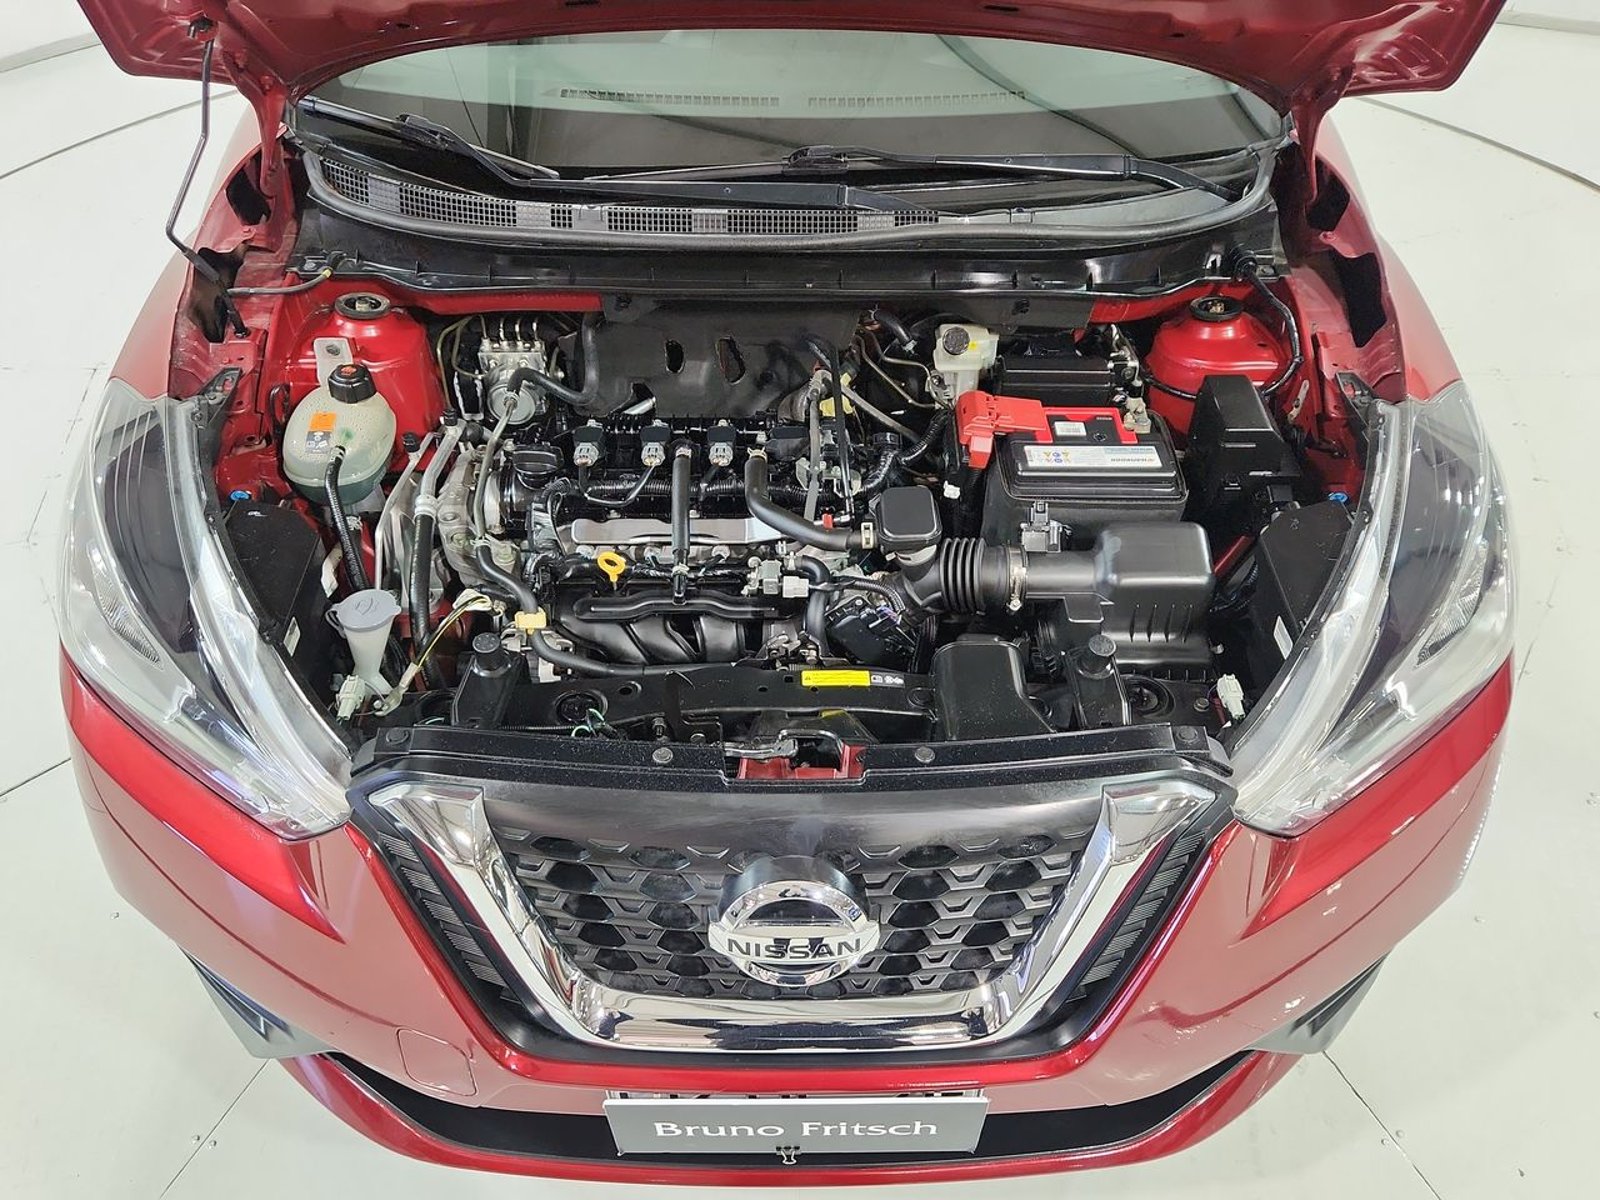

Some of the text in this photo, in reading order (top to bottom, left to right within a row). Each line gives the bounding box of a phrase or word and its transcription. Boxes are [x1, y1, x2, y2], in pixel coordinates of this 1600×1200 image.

[727, 937, 861, 960] NISSAN
[653, 1120, 939, 1137] Bruno Fritsch
